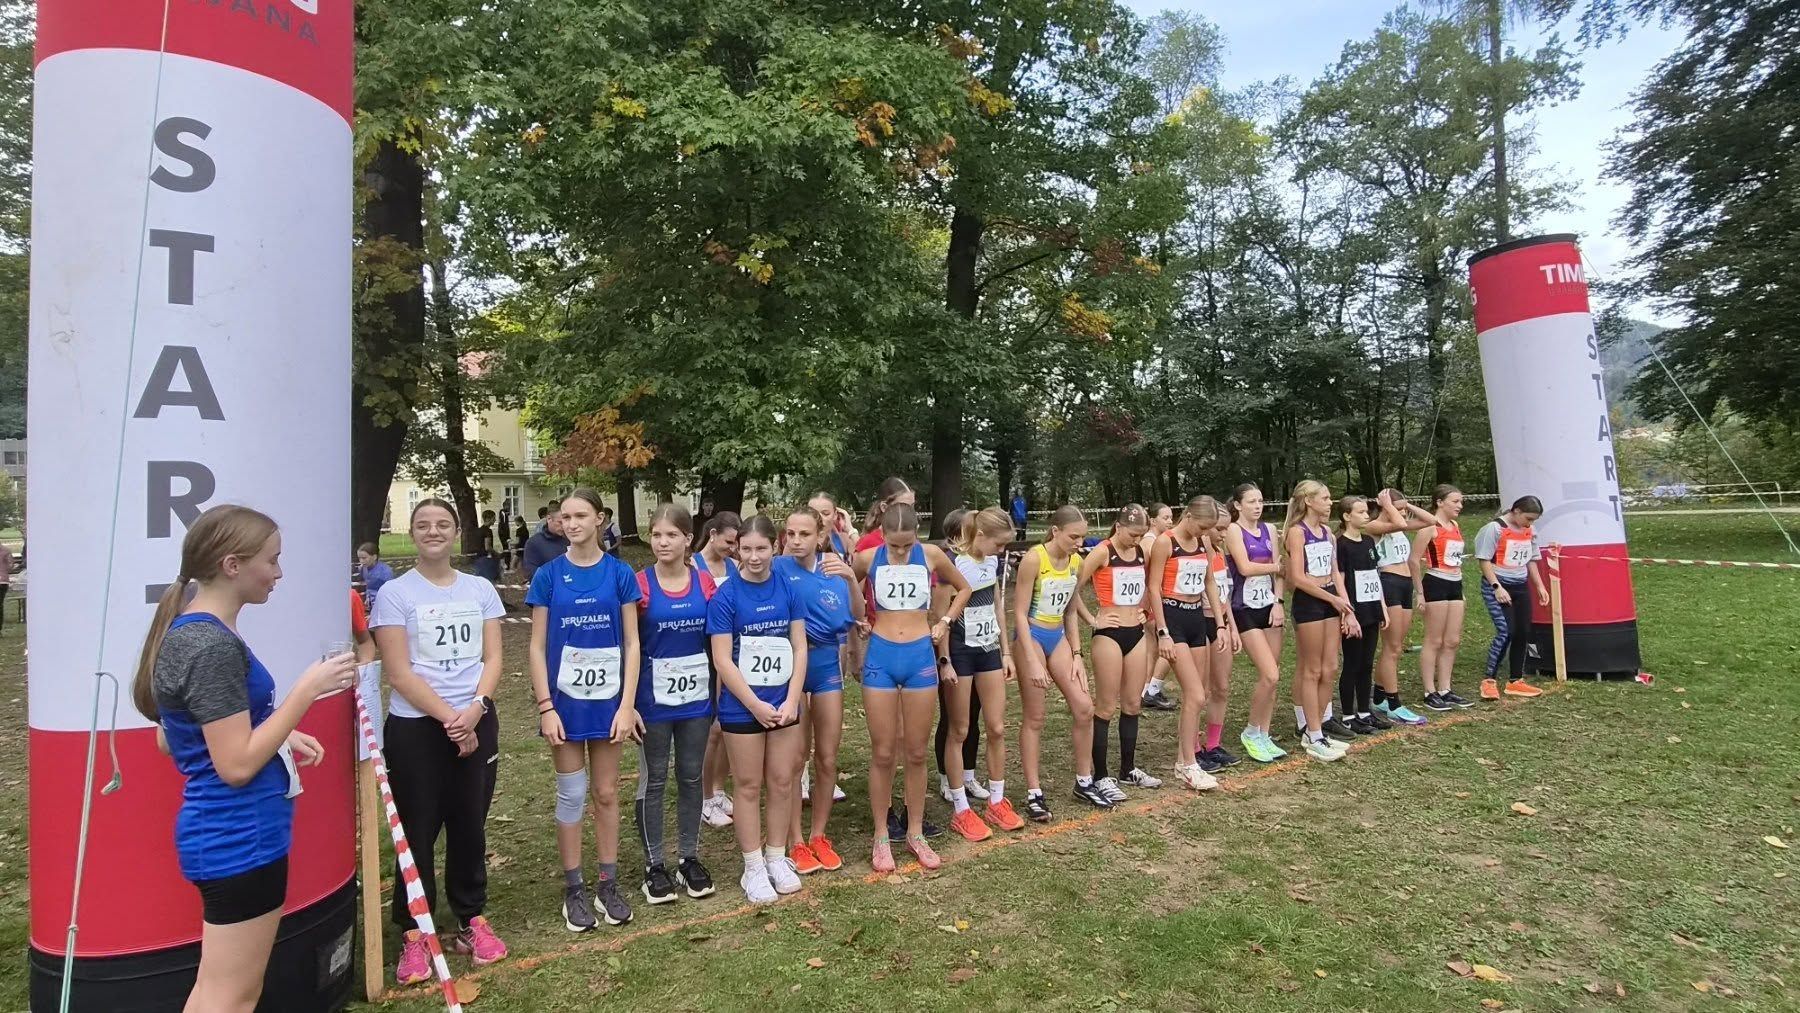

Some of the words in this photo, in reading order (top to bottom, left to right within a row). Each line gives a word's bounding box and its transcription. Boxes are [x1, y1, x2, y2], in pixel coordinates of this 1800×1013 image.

[1539, 263, 1588, 285] TIM
[1184, 573, 1203, 586] 215
[1364, 581, 1380, 594] 208
[887, 582, 917, 598] 212
[1121, 583, 1140, 596] 200
[560, 614, 611, 629] JERUZALEM
[435, 622, 471, 646] 210
[750, 655, 782, 674] 204
[571, 668, 607, 687] 203
[666, 674, 697, 694] 205
